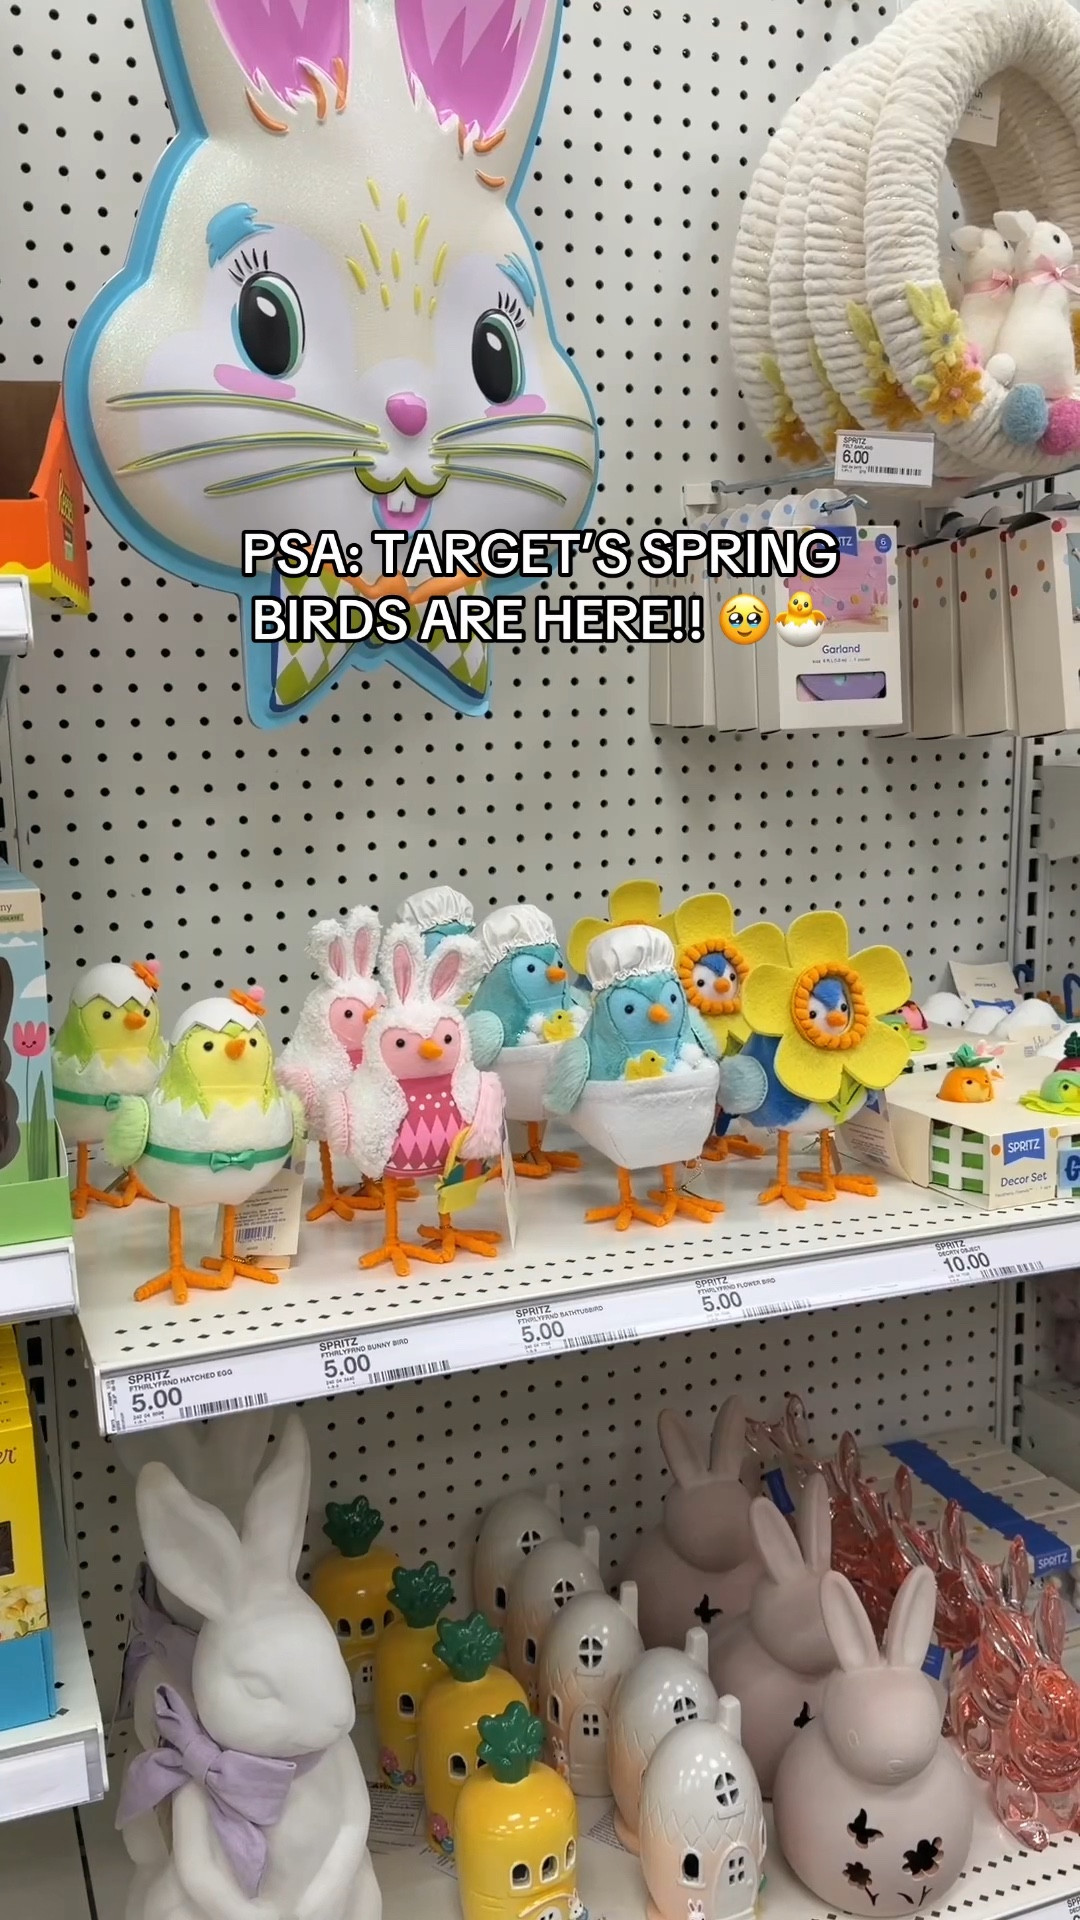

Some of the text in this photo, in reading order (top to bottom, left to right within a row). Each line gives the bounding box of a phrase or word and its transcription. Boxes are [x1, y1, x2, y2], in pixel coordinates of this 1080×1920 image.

[843, 436, 867, 445] SPRITZ
[842, 449, 869, 464] 6.00
[822, 644, 861, 654] Garland
[1008, 1138, 1041, 1153] SPRITZ
[1001, 1175, 1029, 1188] Decor
[1031, 1172, 1048, 1182] Set
[935, 1240, 966, 1251] SPRITZ
[960, 1245, 981, 1254] OBJECT
[943, 1252, 990, 1273] 10.00
[695, 1276, 728, 1289] SPRITZ
[736, 1280, 761, 1289] FLOWER
[762, 1277, 776, 1285] BIRD
[702, 1291, 743, 1312] 5.00
[515, 1305, 552, 1318] SPRITZ
[560, 1305, 604, 1317] BATHTUBBIRD
[521, 1320, 565, 1343] 5.00
[319, 1337, 359, 1352] SPRITZ
[321, 1338, 409, 1359] FTHRLYFRND BUNNY BIRD
[324, 1354, 371, 1378] 5.00
[128, 1369, 171, 1385] SPRITZ
[129, 1368, 233, 1392] FTHRLYFRND HATCHED EGG
[131, 1387, 183, 1413] 5.00
[1038, 1553, 1068, 1569] SPRITZ
